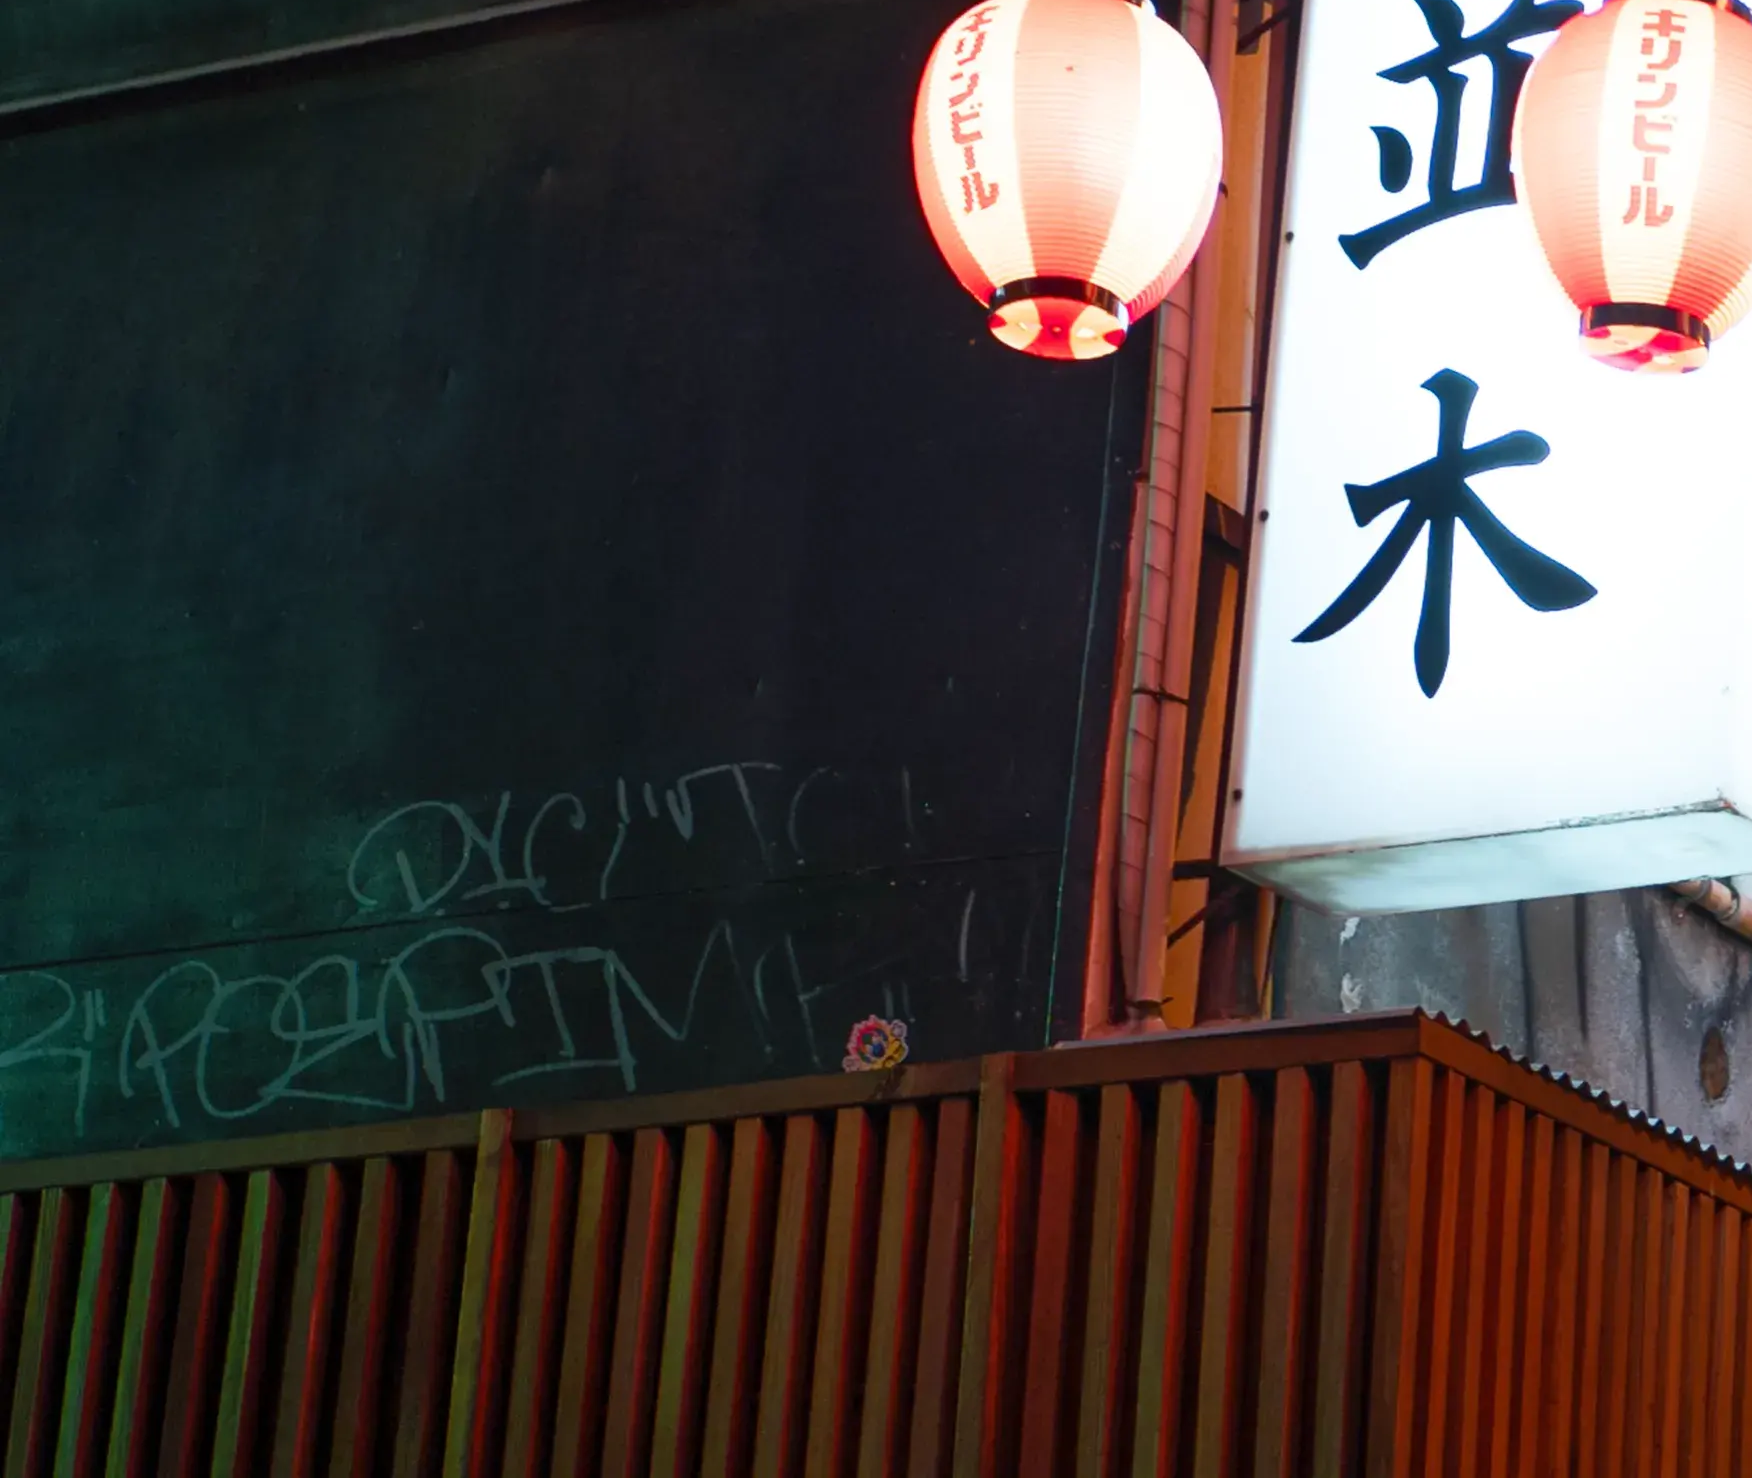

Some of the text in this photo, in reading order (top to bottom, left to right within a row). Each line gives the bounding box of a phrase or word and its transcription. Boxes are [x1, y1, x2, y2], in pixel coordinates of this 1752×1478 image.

[947, 4, 1002, 216] キリンビール
[1623, 8, 1688, 228] キリンビール
